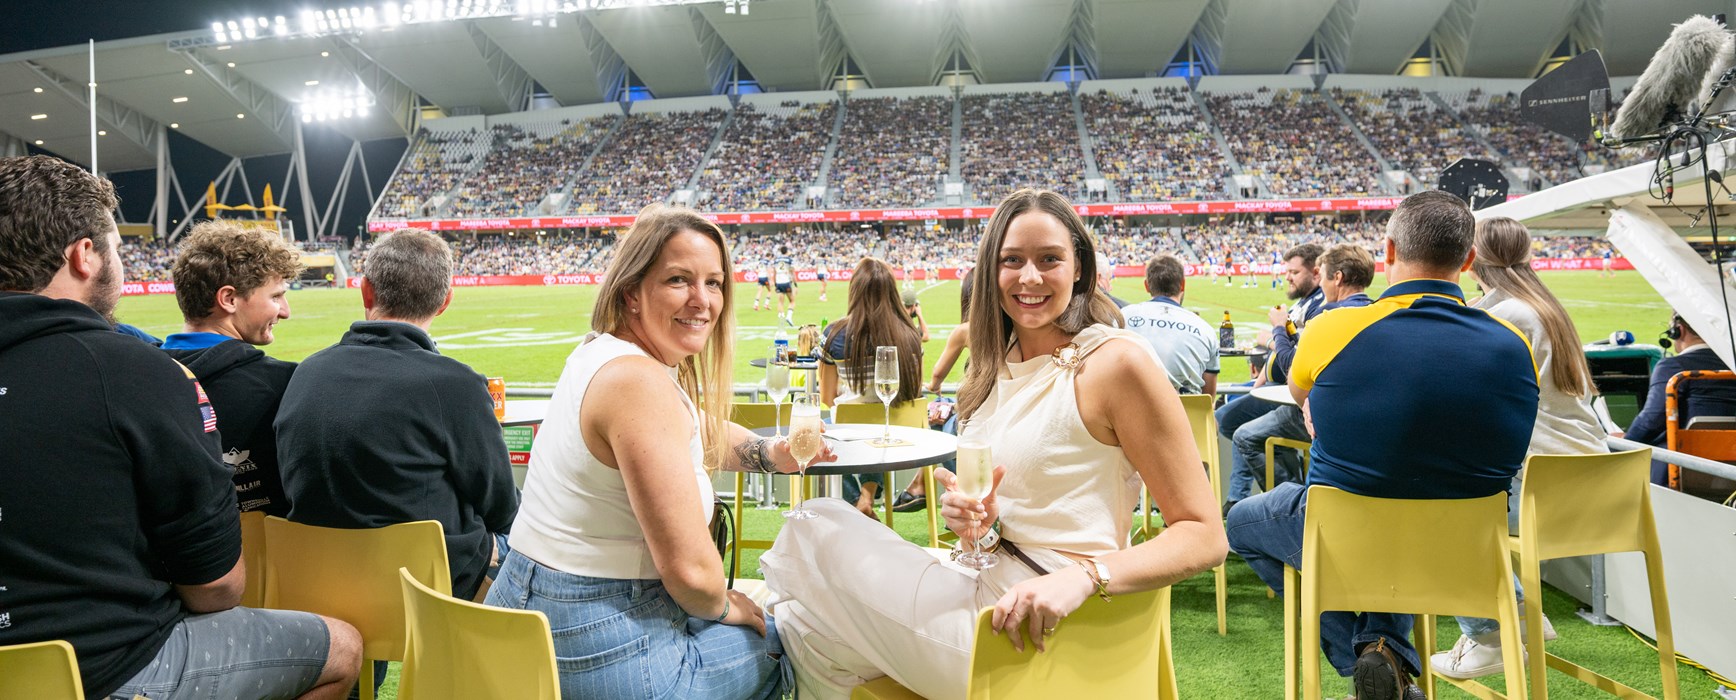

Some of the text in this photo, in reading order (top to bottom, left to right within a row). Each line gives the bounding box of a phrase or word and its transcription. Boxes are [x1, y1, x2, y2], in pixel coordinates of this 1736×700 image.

[454, 276, 479, 285] WHAT
[557, 275, 591, 283] TOYOTA
[1149, 318, 1201, 336] TOYOTA
